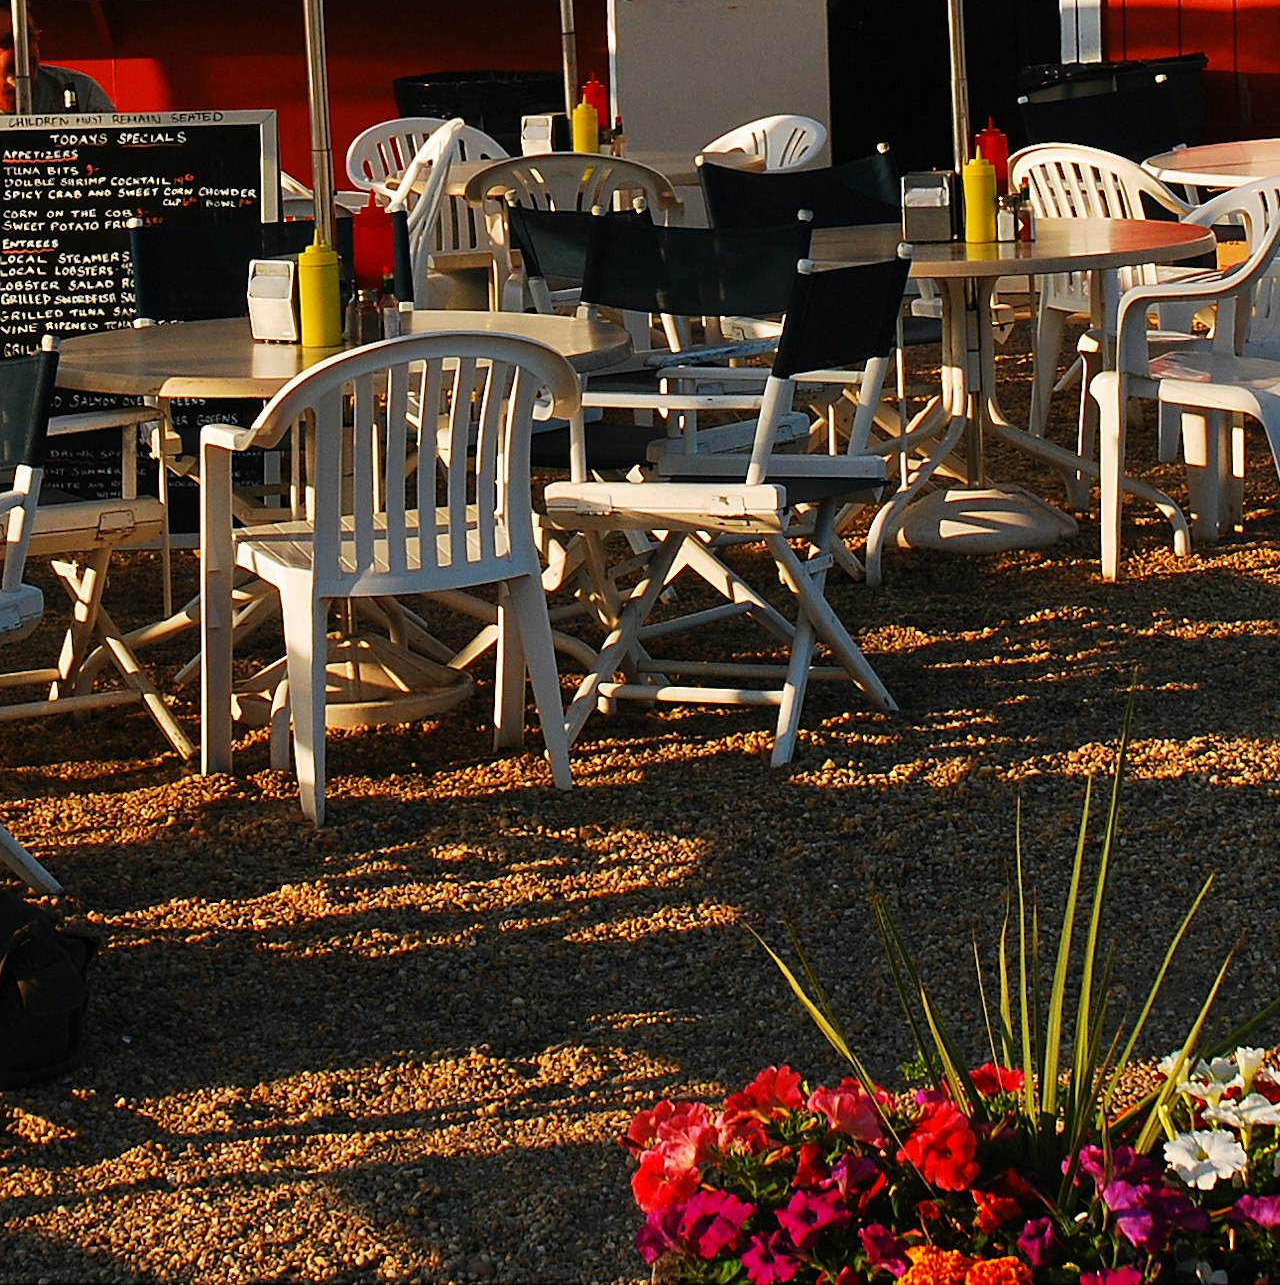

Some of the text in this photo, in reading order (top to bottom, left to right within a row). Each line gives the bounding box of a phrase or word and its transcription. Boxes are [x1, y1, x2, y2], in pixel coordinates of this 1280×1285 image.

[8, 112, 224, 128] CHILDREN MUST REMAIN SEATED
[50, 131, 187, 145] TODAYS SPECIALS
[3, 149, 79, 160] APPETIZERS
[3, 166, 40, 176] TUNA
[46, 166, 79, 175] BITS
[4, 177, 55, 188] DOUBLE
[60, 177, 106, 186] SHRIMP
[110, 176, 171, 186] COCKTAIL
[3, 186, 257, 200] SPICY CRAB AND SWEET CORN CHOWDER
[162, 198, 181, 206] CUP
[3, 209, 38, 219] CORN
[46, 210, 64, 218] ON
[70, 209, 97, 218] THE
[105, 209, 133, 218] COB
[2, 221, 45, 231] SWEET
[50, 221, 99, 232] POTATO
[2, 238, 59, 249] ENTREES
[0, 251, 130, 265] LOCAL STEAMERS
[0, 267, 47, 277] LOCAL
[55, 265, 114, 277] LOBSTERS
[0, 280, 60, 291] LOBSTER
[68, 280, 114, 291] SALAD
[1, 294, 51, 305] GRILLED
[0, 309, 63, 322] GRILLED
[69, 308, 105, 317] TUNA
[0, 322, 38, 335] VINE
[69, 394, 116, 408] SALMON
[122, 396, 143, 407] OVE
